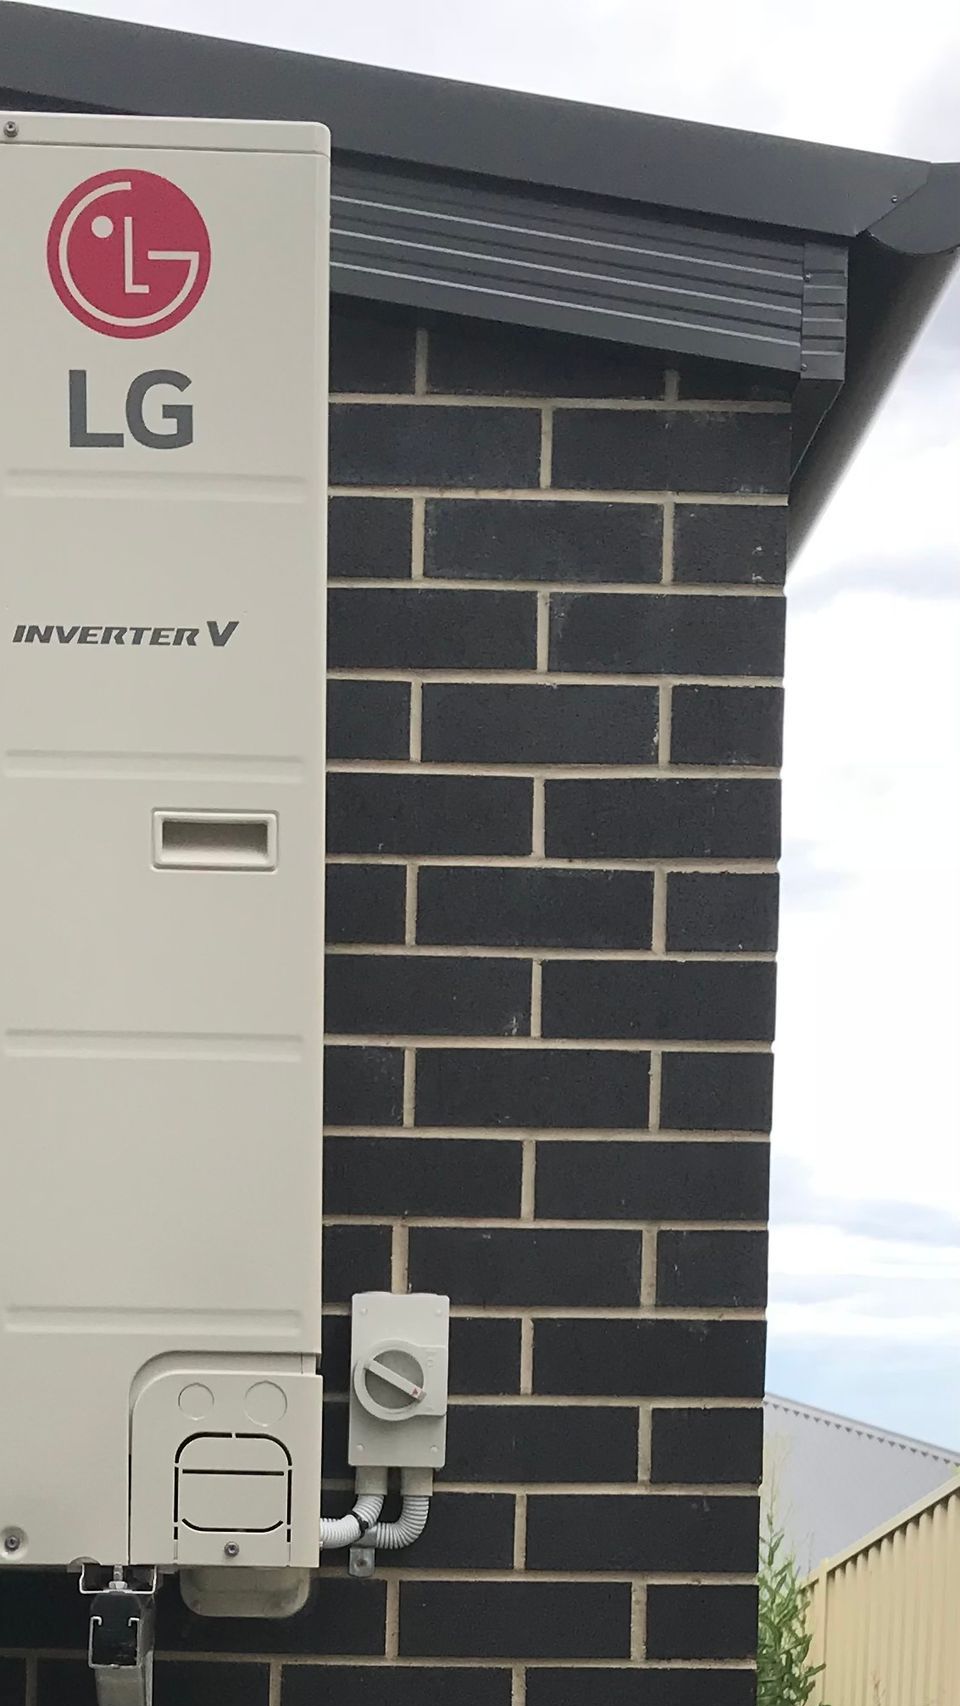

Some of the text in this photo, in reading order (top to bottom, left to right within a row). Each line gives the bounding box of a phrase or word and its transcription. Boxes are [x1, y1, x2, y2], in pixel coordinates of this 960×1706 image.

[68, 369, 193, 450] LG
[13, 620, 240, 647] INVERTER V
